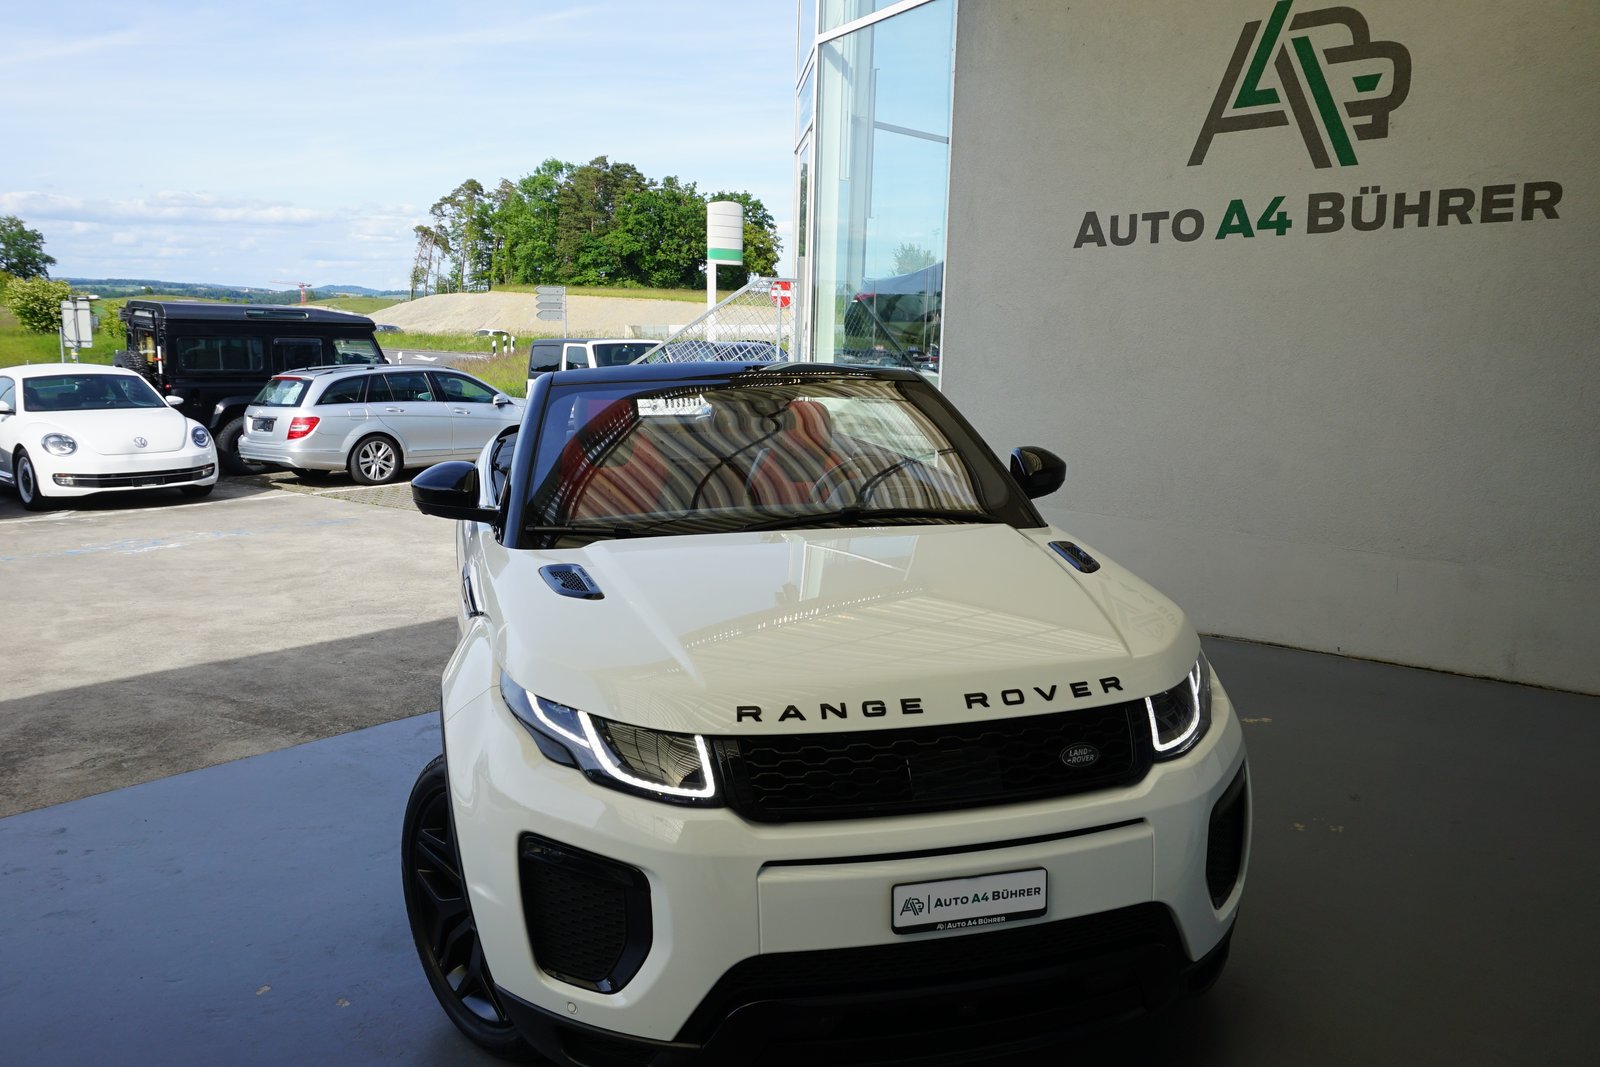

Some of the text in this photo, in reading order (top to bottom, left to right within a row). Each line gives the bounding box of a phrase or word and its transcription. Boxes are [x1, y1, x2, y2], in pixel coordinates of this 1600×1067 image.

[1072, 180, 1564, 249] AUTO A4 BÜHRER
[736, 676, 1124, 723] RANGE ROVER
[1069, 747, 1088, 757] LAND
[1071, 754, 1095, 763] ROVER
[934, 896, 969, 909] AUTO
[971, 892, 990, 904] A4
[992, 887, 1041, 901] BÜHRER
[946, 921, 967, 929] AUTO
